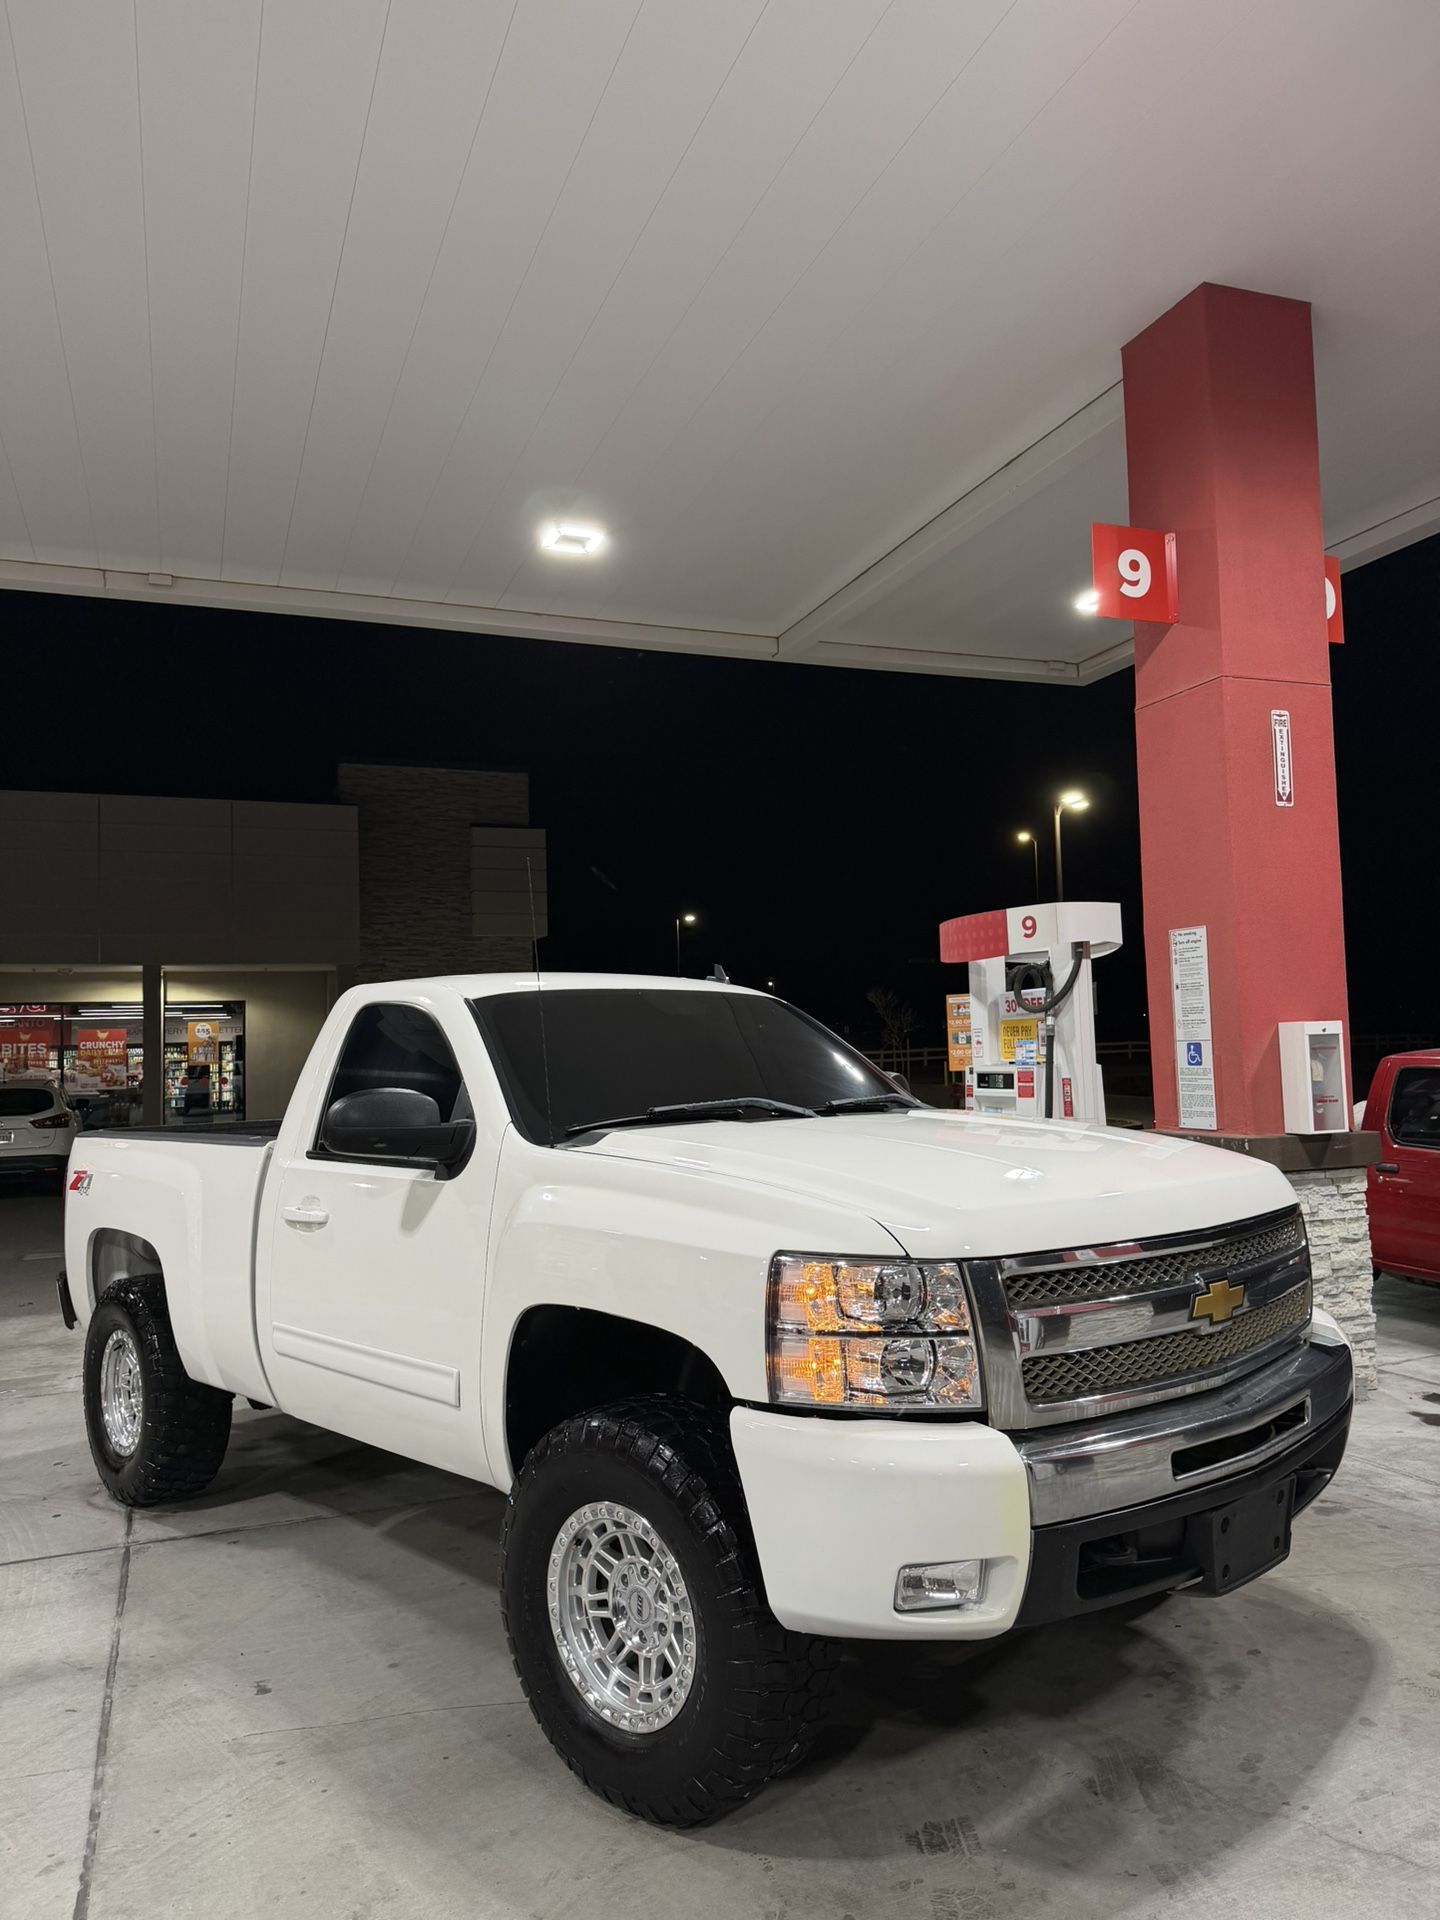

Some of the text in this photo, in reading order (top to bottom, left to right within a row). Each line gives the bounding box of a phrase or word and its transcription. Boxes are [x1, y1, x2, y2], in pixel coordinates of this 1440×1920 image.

[1118, 549, 1151, 598] 9
[1278, 728, 1287, 797] EXTINGUISHER
[1021, 915, 1038, 938] 9
[1003, 1025, 1032, 1037] NEVER PAY
[1, 1043, 47, 1055] BITES
[80, 1041, 125, 1049] CRUNCHY
